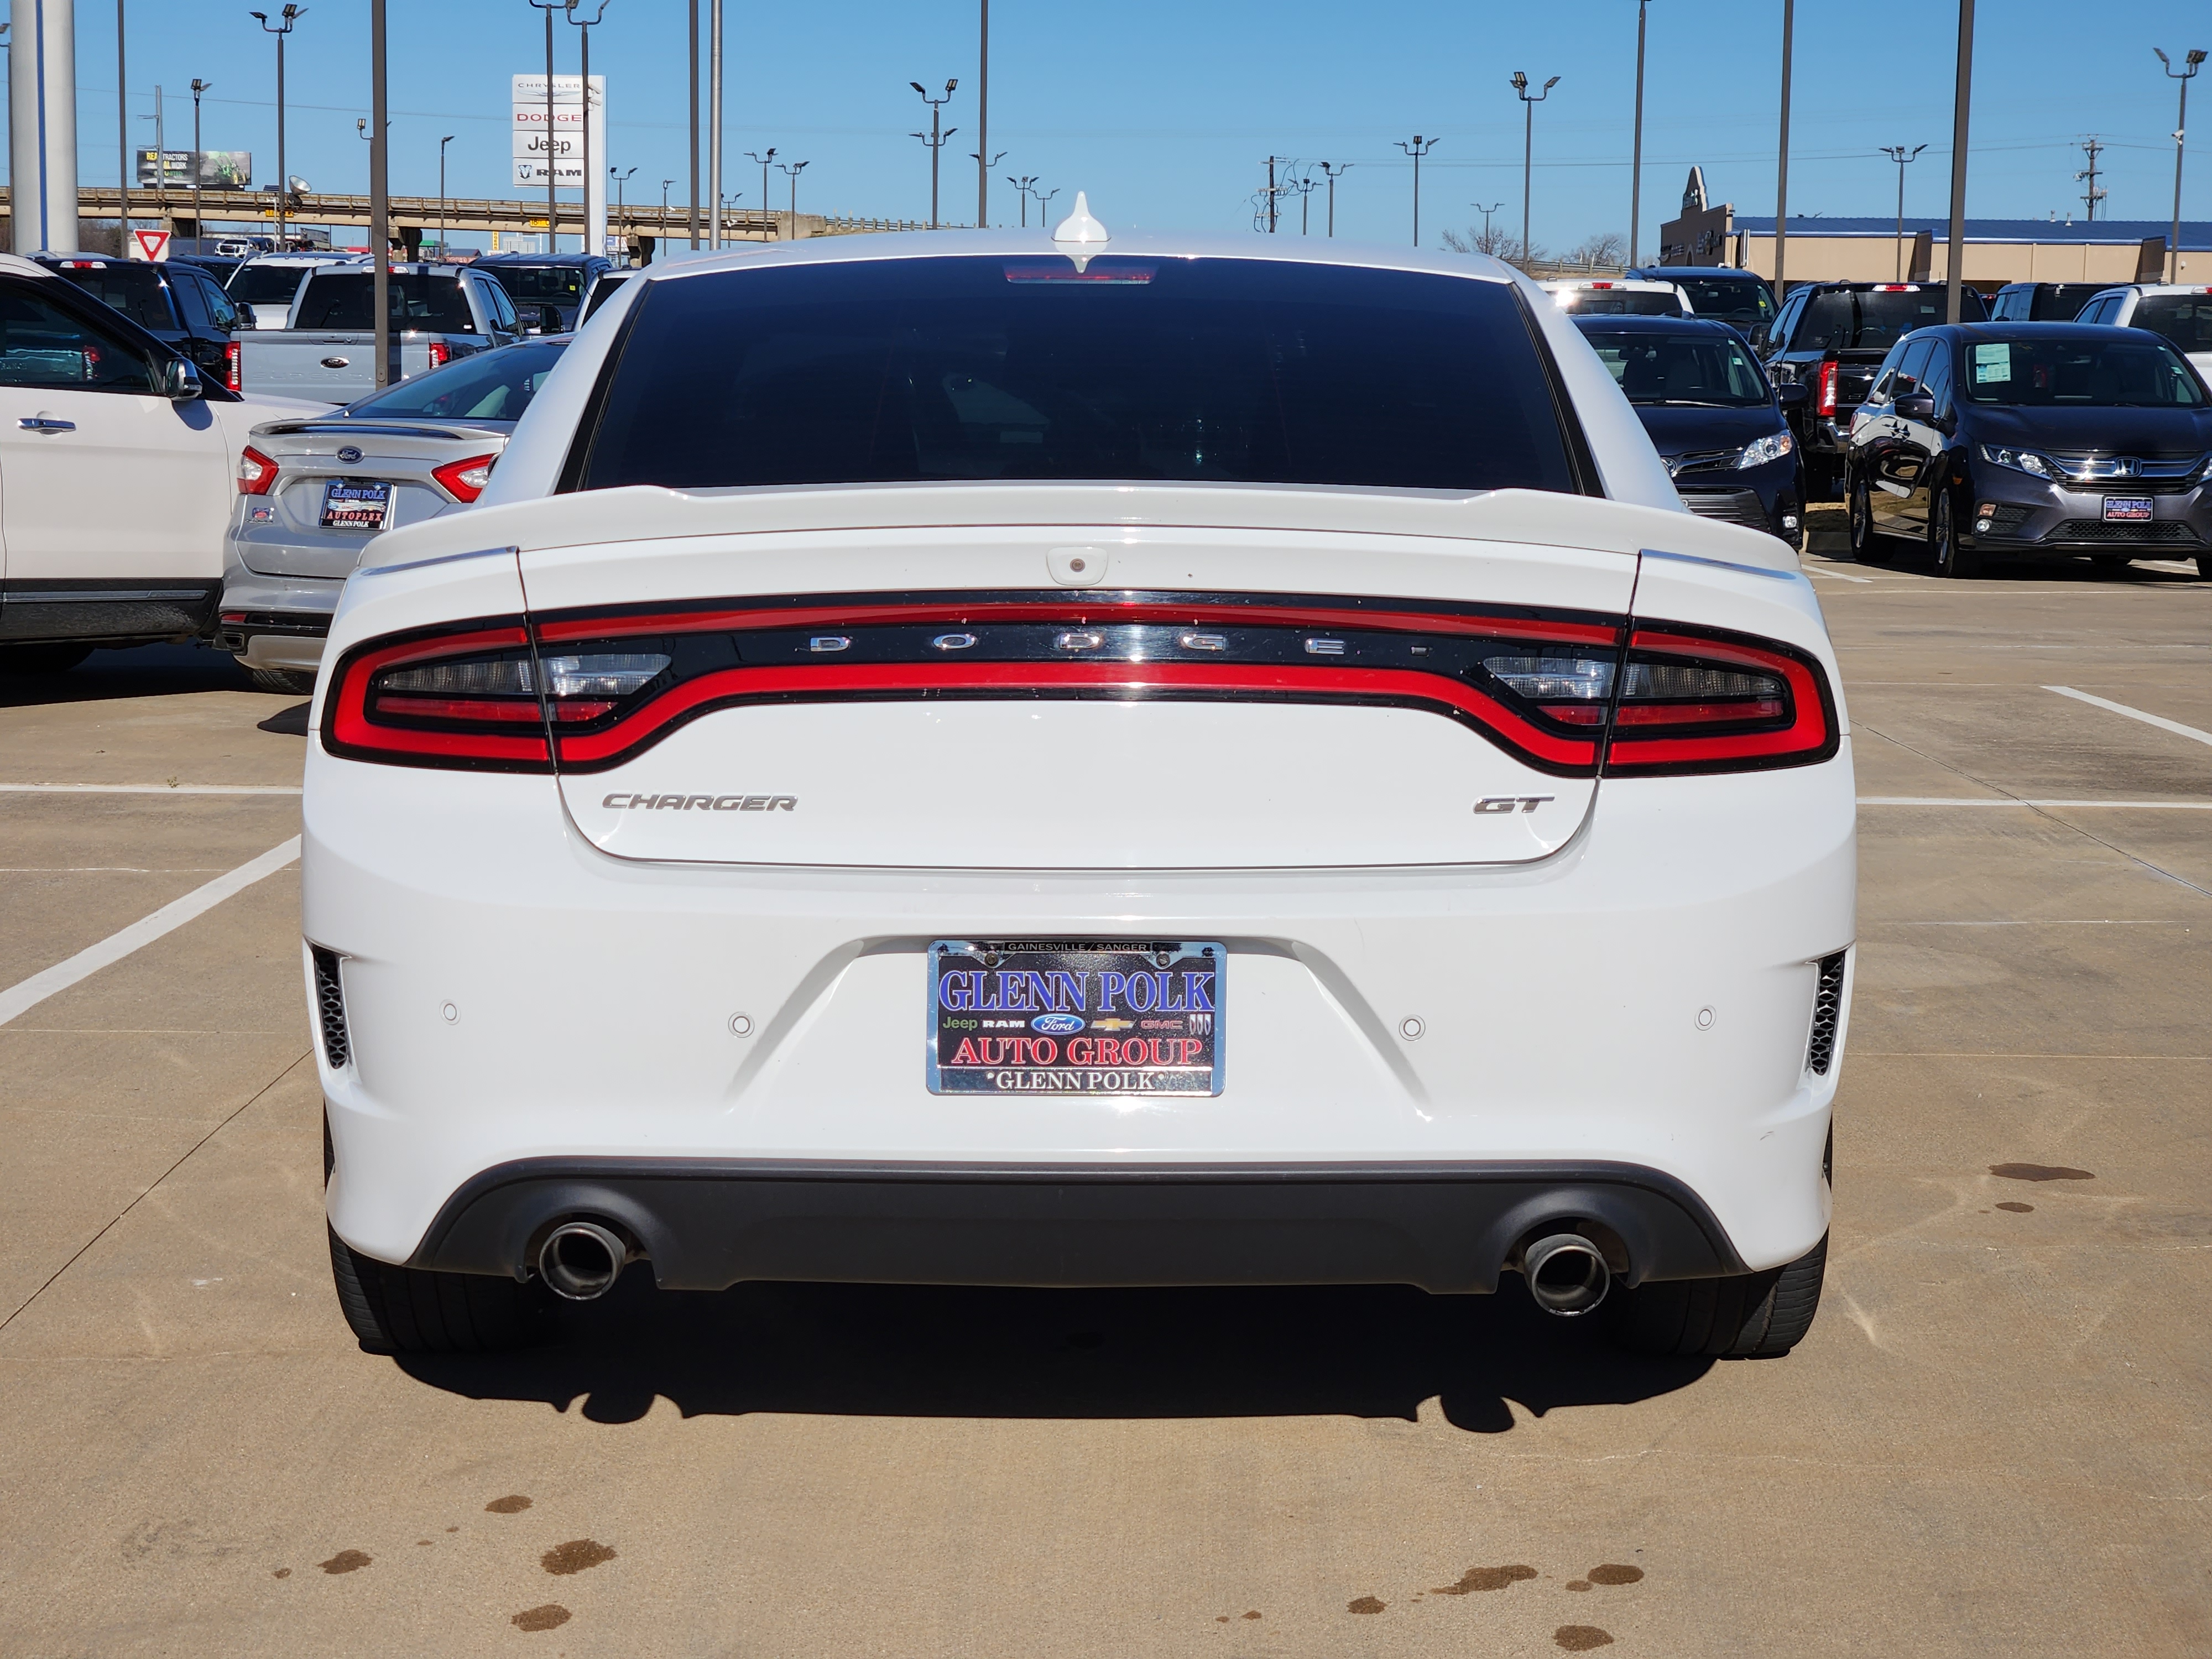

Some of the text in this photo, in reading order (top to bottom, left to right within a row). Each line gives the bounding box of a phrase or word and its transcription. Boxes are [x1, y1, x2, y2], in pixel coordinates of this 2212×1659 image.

[528, 137, 571, 154] Jeep
[163, 153, 188, 161] TRACTORS
[340, 450, 357, 460] Ford
[332, 489, 386, 499] GLENN POLK
[327, 511, 382, 521] AUTOPLEX
[810, 633, 1345, 655] DODGE
[602, 793, 799, 811] CHARGER
[1473, 796, 1555, 815] GT
[1008, 942, 1086, 952] GAINESVILLE
[1097, 943, 1147, 952] SANGER
[939, 970, 1215, 1012] GLENN POLK
[942, 1016, 1184, 1031] Jeep RAM Ford GMC
[951, 1037, 1203, 1065] AUTO GROUP
[997, 1071, 1156, 1089] GLENN POLK
